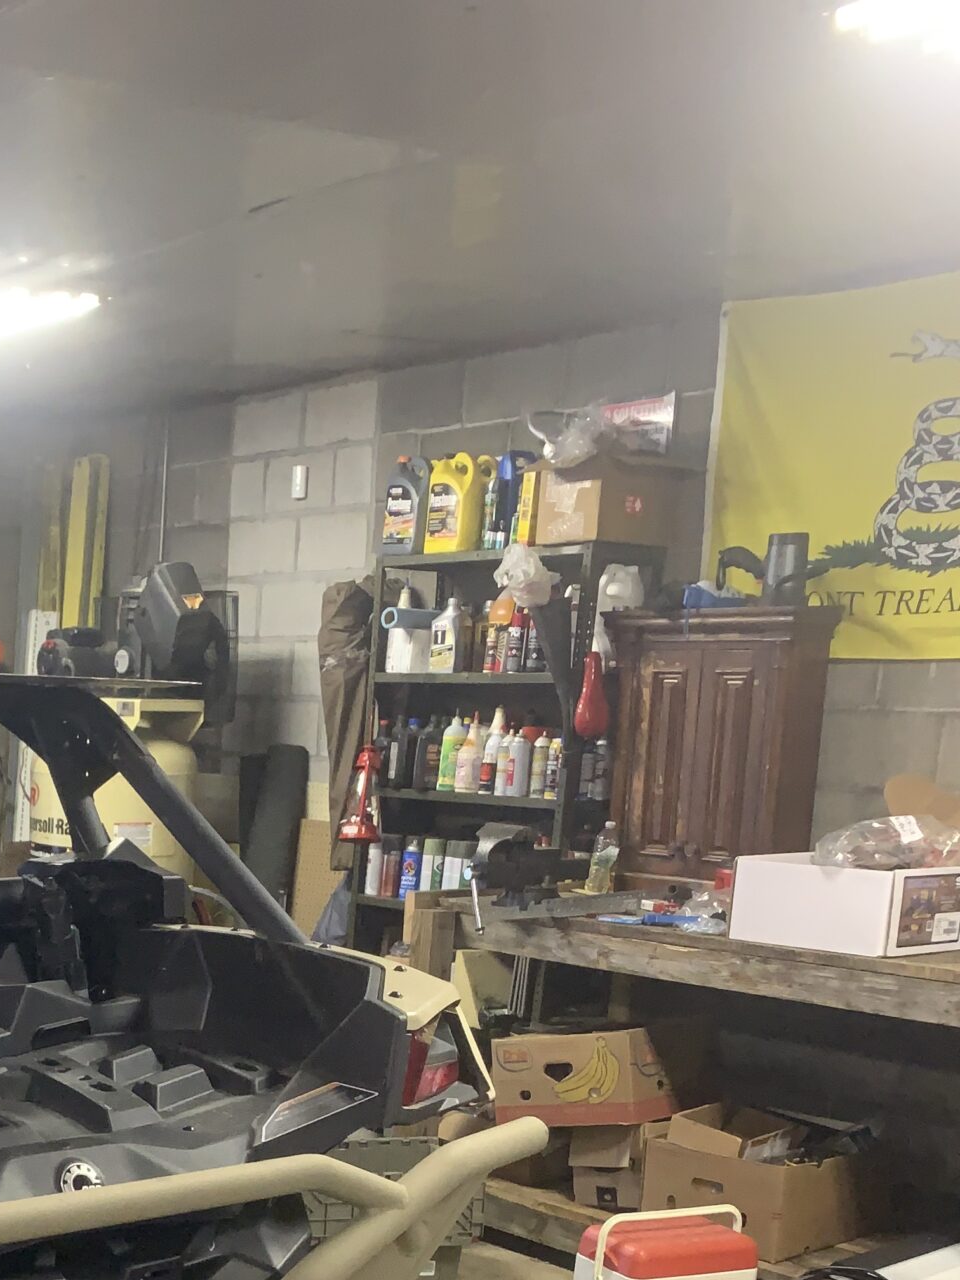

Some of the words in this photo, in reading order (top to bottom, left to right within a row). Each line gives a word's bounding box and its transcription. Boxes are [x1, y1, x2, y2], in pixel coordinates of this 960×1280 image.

[807, 590, 865, 616] ONT
[873, 587, 960, 616] TREA
[30, 816, 54, 834] ersoll
[55, 818, 71, 836] Ra
